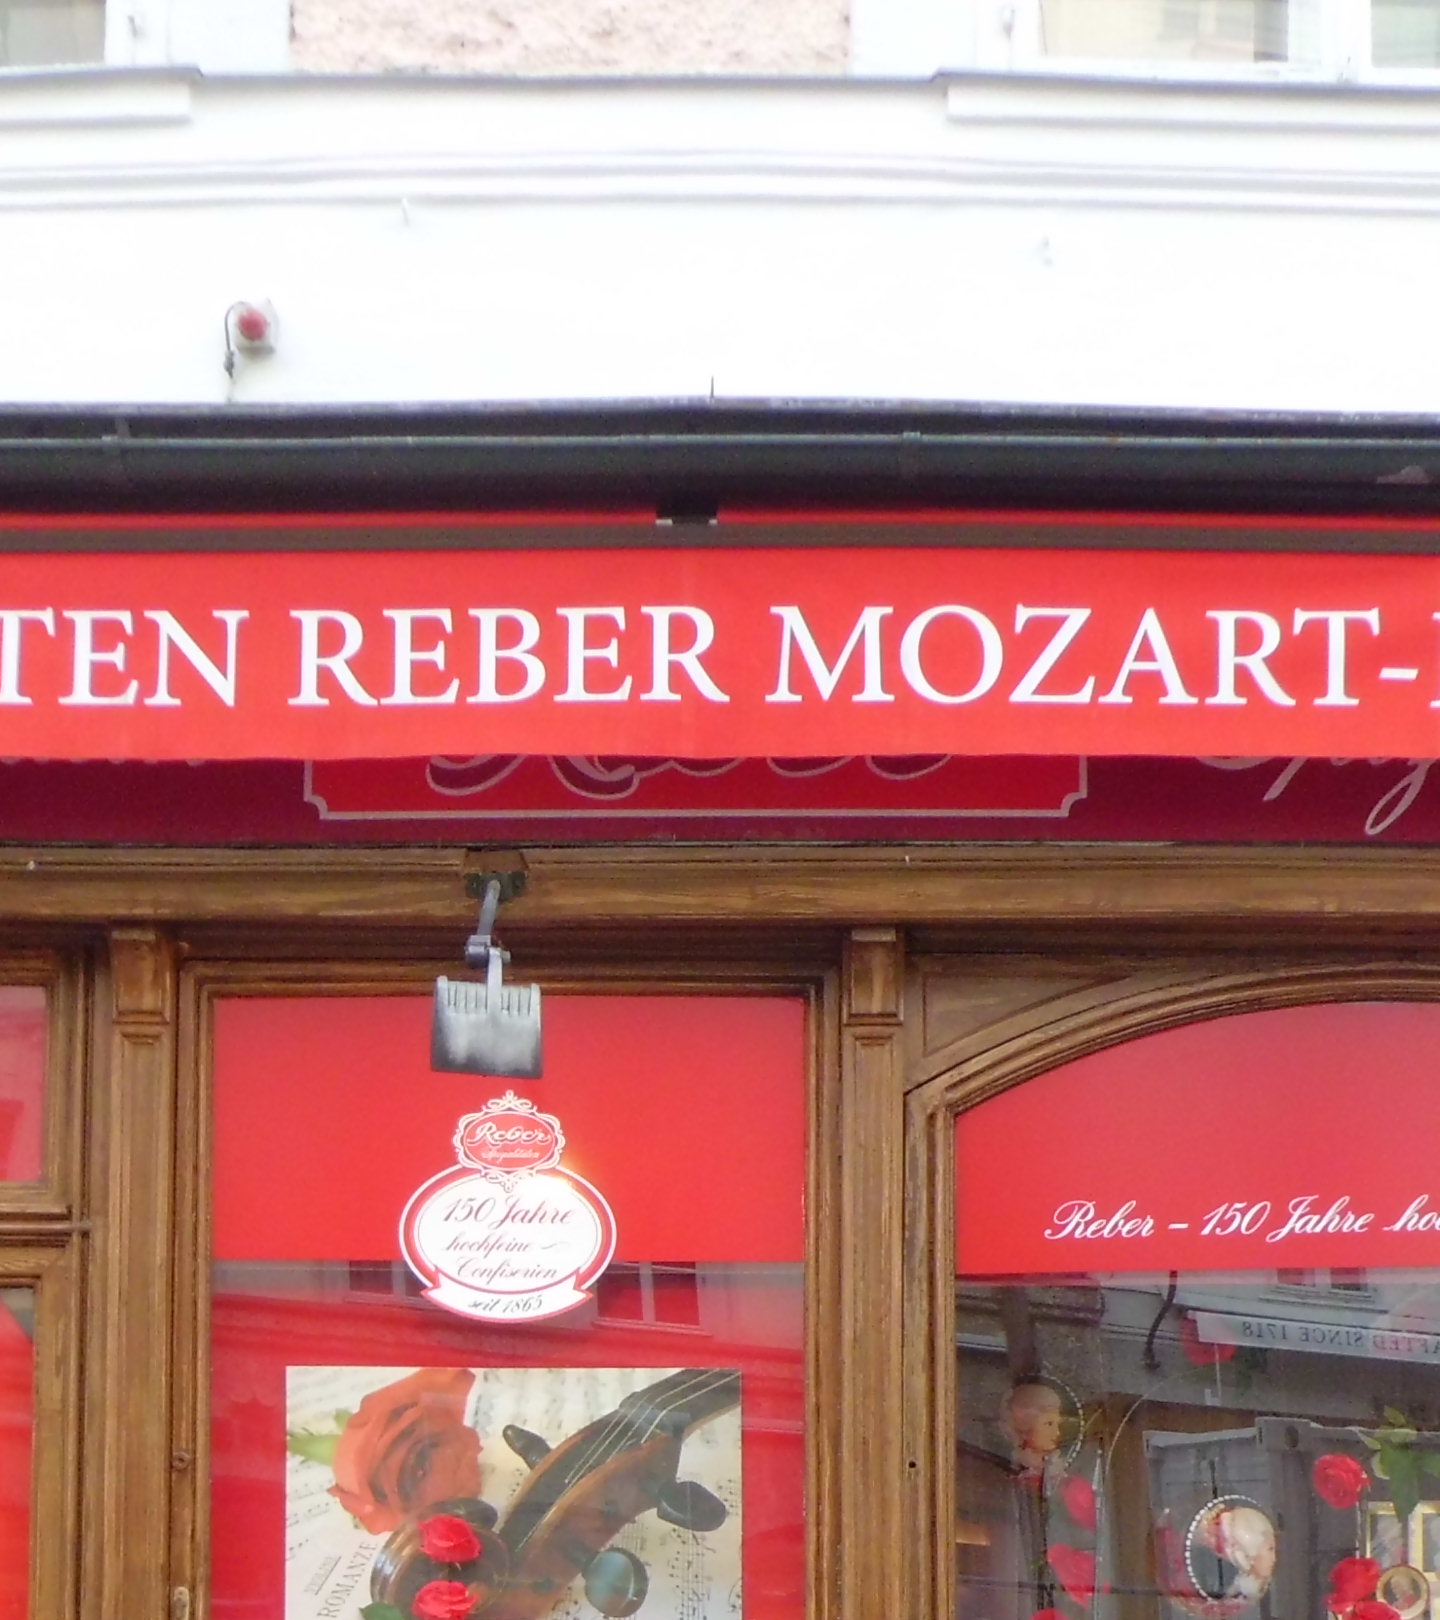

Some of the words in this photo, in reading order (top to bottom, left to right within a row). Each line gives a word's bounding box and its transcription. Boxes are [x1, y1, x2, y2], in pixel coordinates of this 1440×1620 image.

[286, 604, 732, 707] REBER
[466, 1121, 552, 1147] Reber
[442, 1196, 497, 1224] 150
[488, 1195, 575, 1230] Jahre
[1044, 1200, 1155, 1240] Reber
[1200, 1201, 1271, 1236] 150
[1265, 1195, 1375, 1243] Jahre
[443, 1232, 534, 1258] hochfeine
[456, 1255, 558, 1285] Confiserien
[468, 1298, 499, 1312] seit
[502, 1295, 543, 1314] 1865
[316, 1541, 378, 1619] ROMANZE
